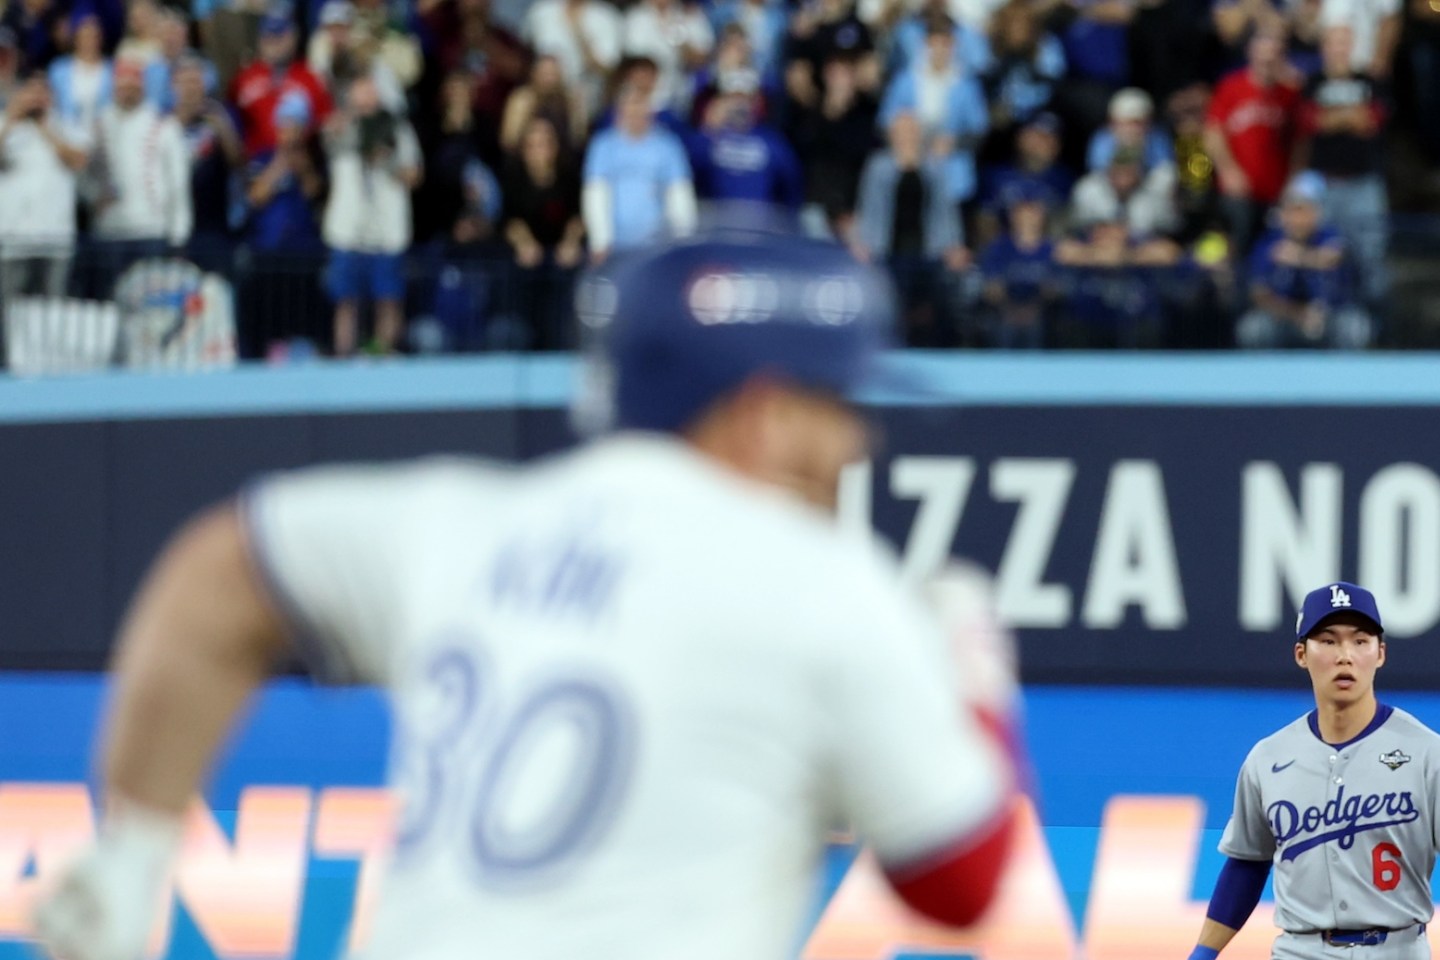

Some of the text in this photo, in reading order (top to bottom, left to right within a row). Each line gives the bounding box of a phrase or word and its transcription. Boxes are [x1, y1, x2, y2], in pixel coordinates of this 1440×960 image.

[1330, 585, 1352, 608] LA
[1267, 785, 1419, 855] Dodgers
[1371, 842, 1402, 891] 6
